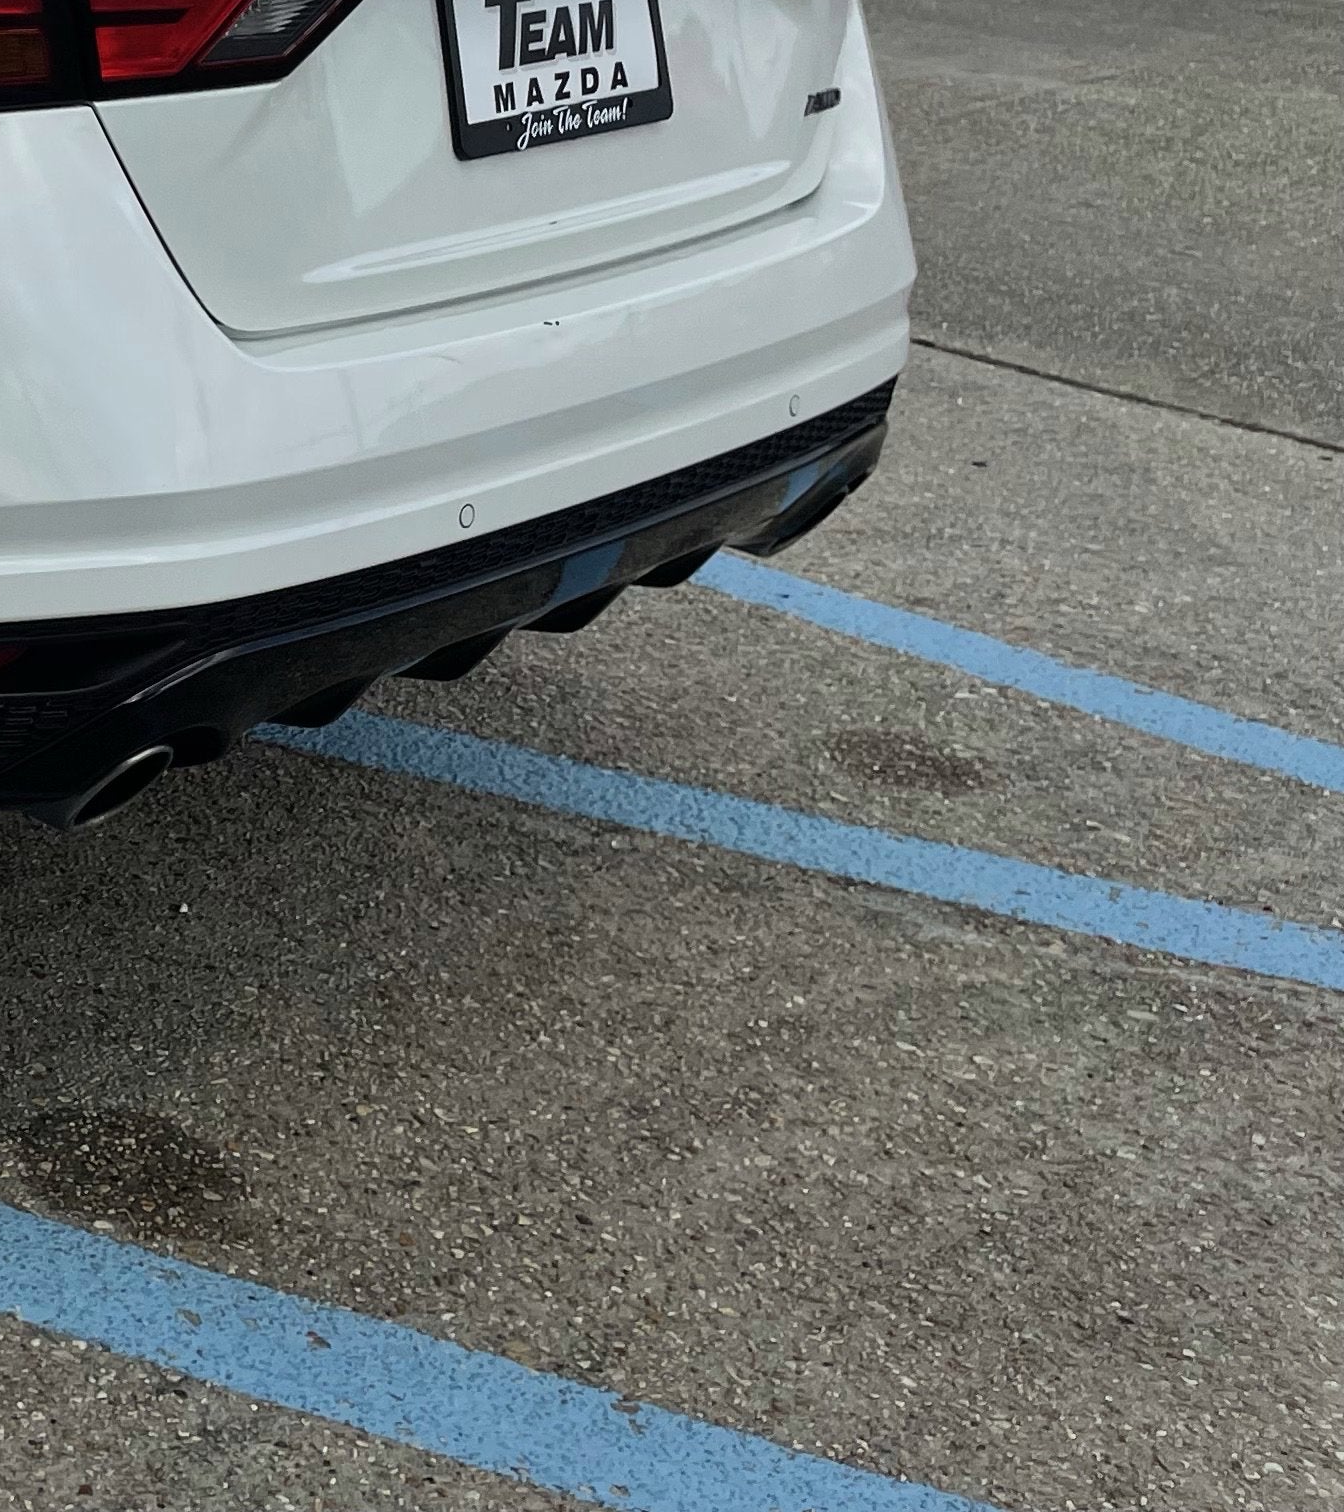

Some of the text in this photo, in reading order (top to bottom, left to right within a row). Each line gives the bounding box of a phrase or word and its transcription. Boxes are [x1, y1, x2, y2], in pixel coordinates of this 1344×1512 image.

[493, 61, 629, 114] MAZDA
[517, 97, 628, 150] Join The Team!
